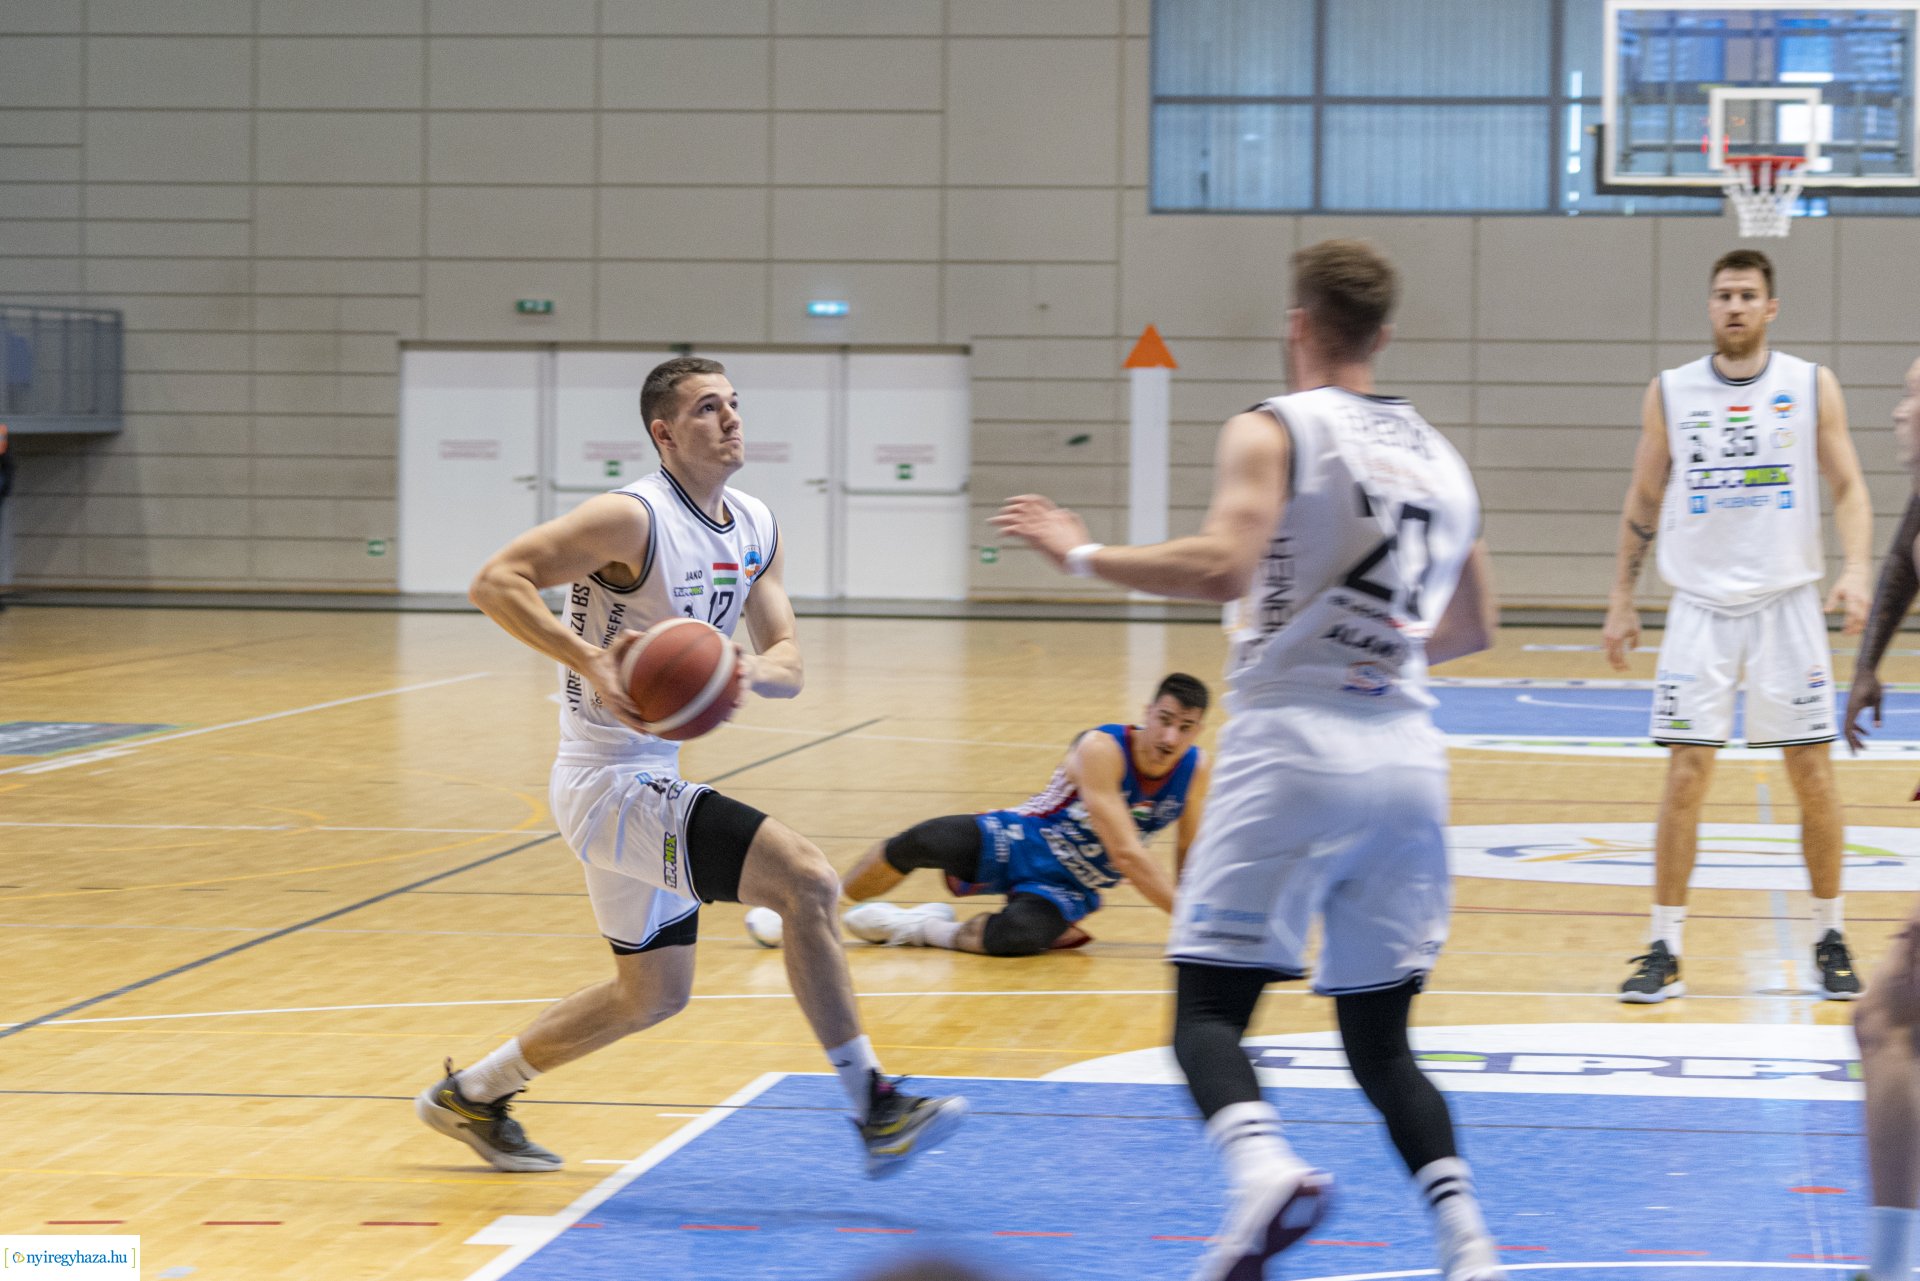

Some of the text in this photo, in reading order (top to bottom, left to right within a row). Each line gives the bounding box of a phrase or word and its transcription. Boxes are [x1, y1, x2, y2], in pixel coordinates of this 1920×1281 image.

[685, 570, 703, 581] JAKO
[572, 583, 591, 607] BS
[707, 591, 734, 629] 12
